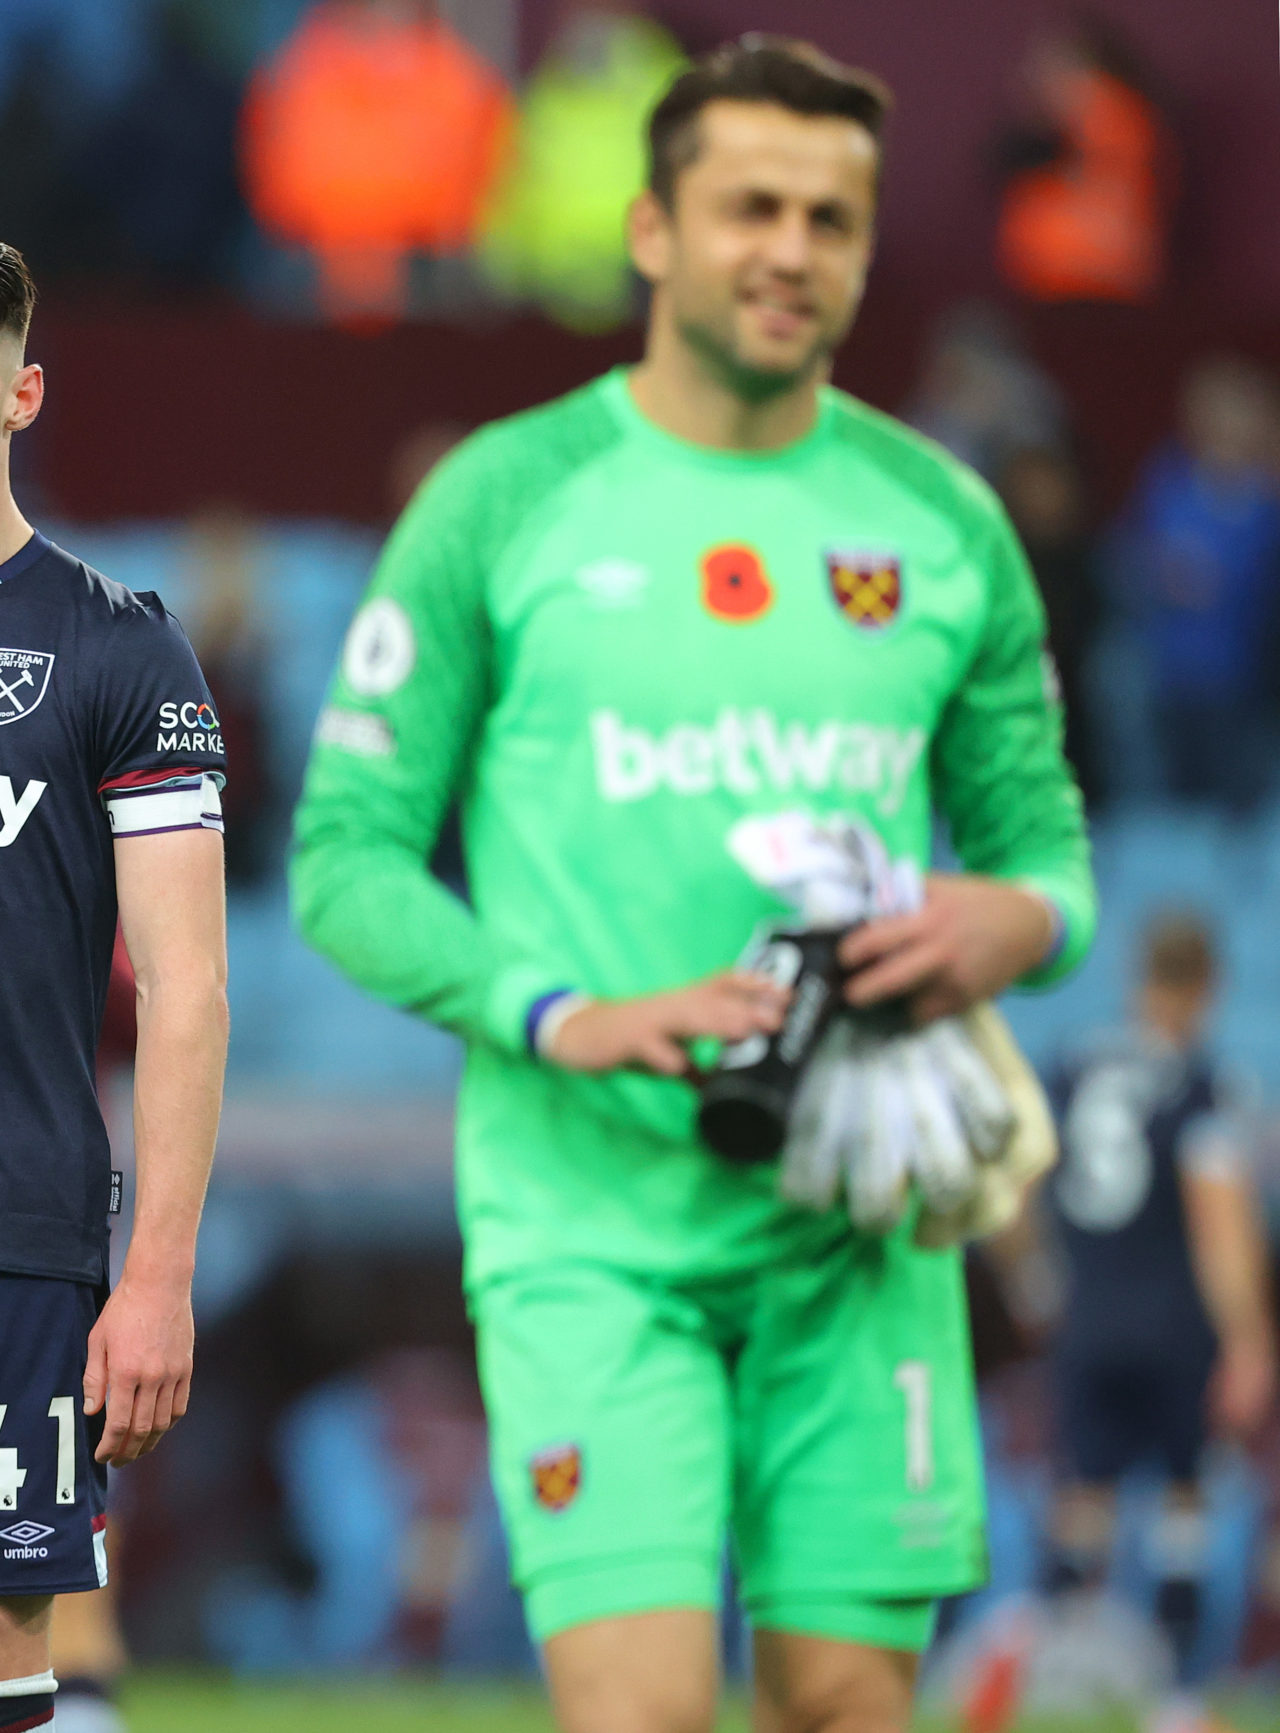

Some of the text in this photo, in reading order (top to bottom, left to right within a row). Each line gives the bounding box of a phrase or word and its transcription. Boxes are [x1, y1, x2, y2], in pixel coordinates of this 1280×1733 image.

[17, 653, 44, 666] HAM
[589, 706, 925, 818] betway
[893, 1359, 934, 1494] 1
[3, 1545, 48, 1560] umbro
